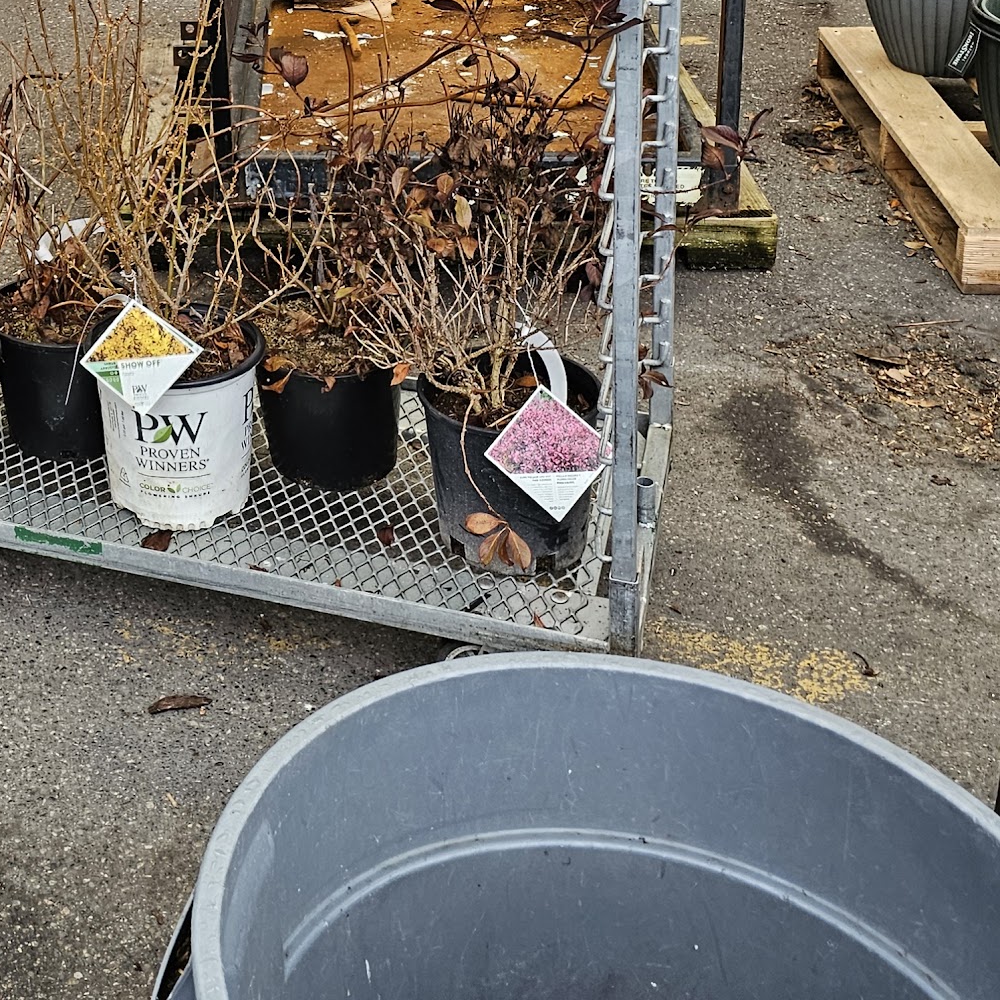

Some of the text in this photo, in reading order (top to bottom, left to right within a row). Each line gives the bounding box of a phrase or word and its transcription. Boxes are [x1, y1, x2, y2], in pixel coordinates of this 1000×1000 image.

[121, 358, 161, 369] SHOW OFF
[140, 445, 200, 460] PROVEN
[139, 482, 166, 493] COLOR
